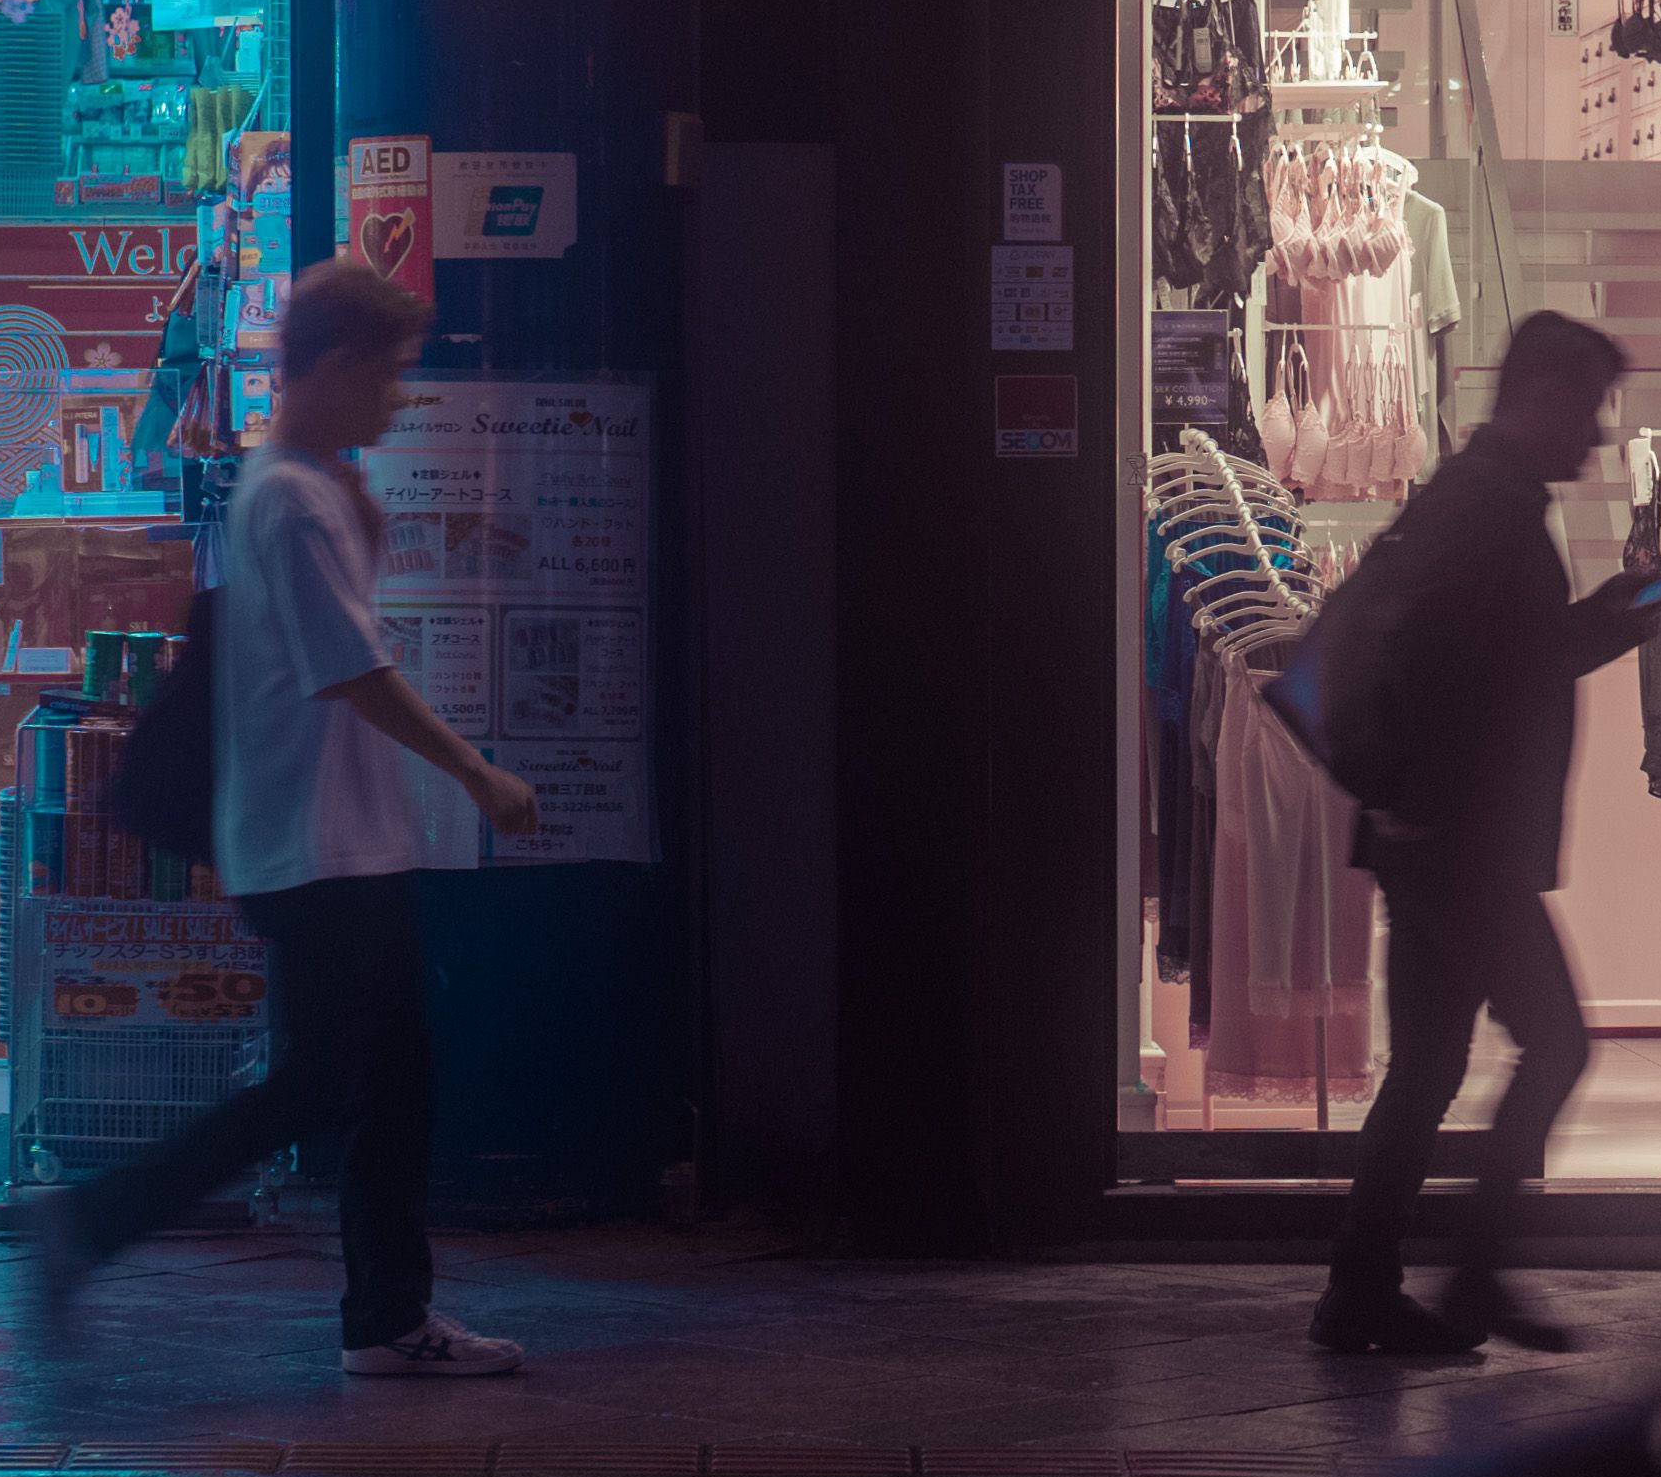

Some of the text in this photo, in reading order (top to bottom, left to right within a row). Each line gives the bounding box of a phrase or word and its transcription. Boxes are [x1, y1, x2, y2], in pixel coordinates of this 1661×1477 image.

[360, 146, 411, 175] AED
[1009, 169, 1048, 182] SHOP
[1009, 183, 1038, 196] TAX
[1009, 197, 1045, 210] FREE
[471, 413, 639, 438] Sweetie Nail
[1000, 431, 1074, 451] SECOM
[537, 555, 571, 572] ALL
[515, 758, 579, 774] Sweetie
